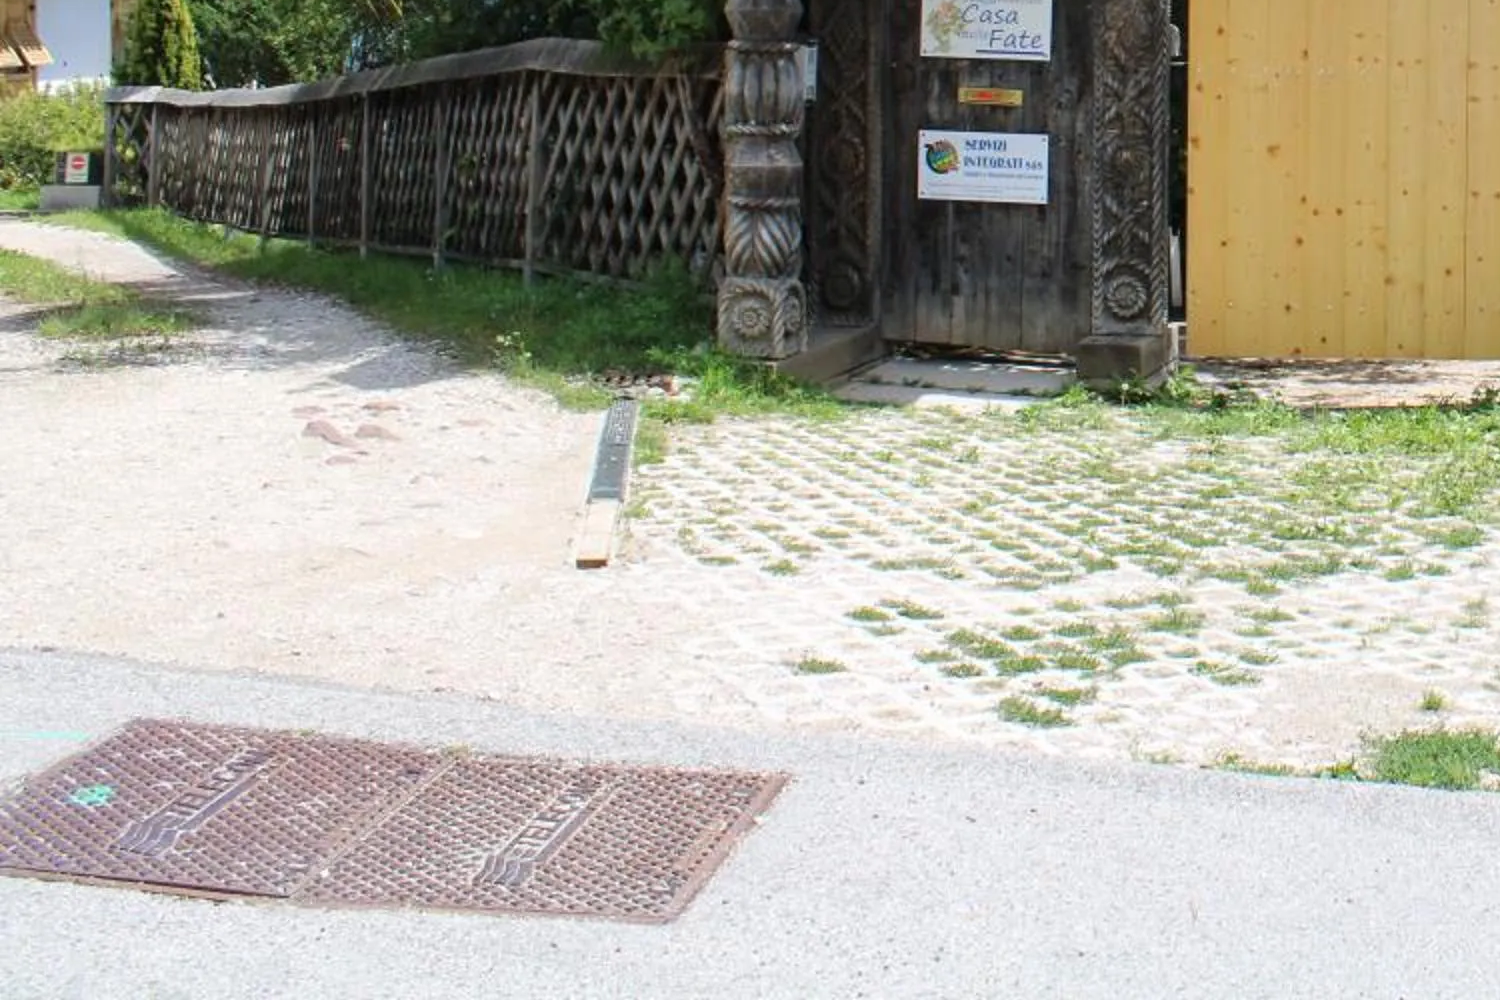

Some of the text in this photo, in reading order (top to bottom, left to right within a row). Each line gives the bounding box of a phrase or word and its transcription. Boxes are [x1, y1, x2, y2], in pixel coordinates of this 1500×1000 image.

[961, 3, 1019, 25] Casa
[989, 29, 1044, 49] Fate
[965, 139, 1007, 152] SERVIZI
[963, 156, 1023, 169] INTEGRATI
